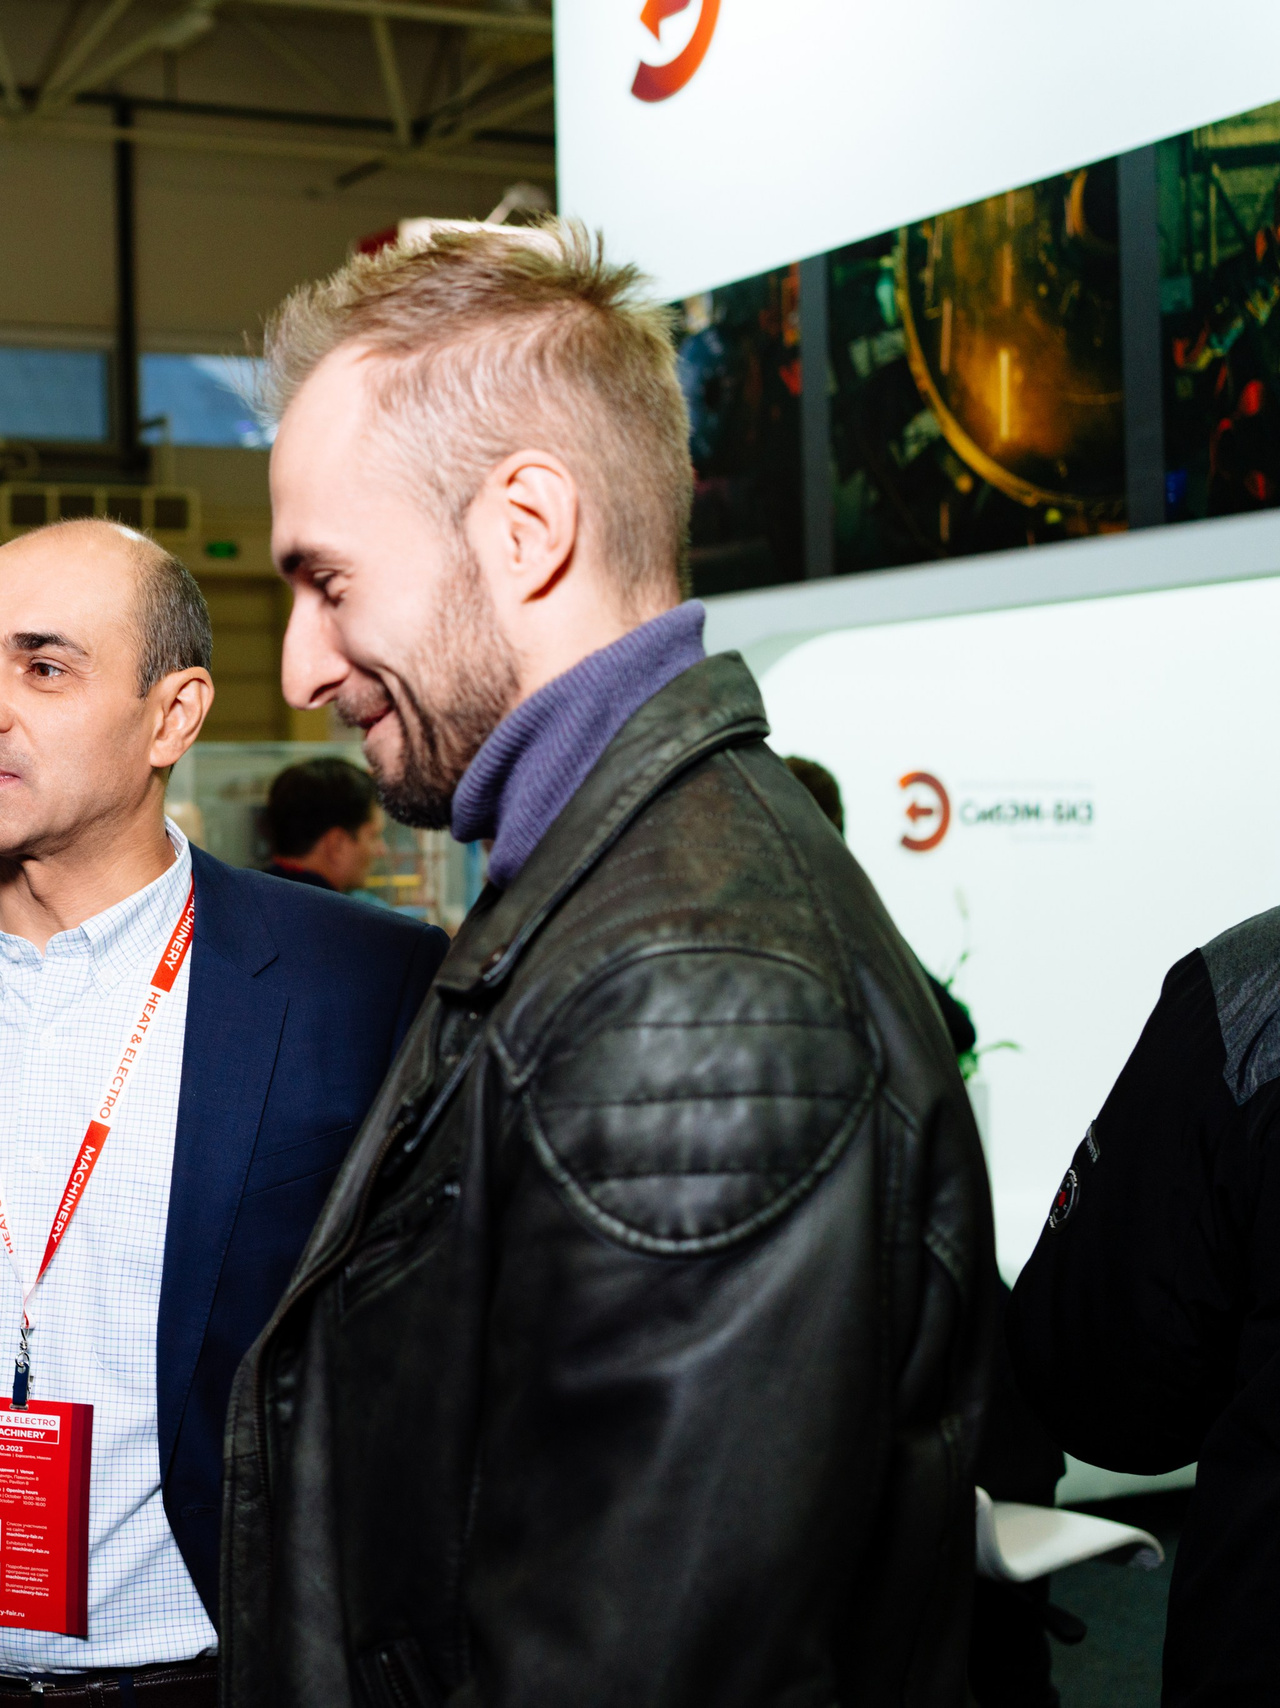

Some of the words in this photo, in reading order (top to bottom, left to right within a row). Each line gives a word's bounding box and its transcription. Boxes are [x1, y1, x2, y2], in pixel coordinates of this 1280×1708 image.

[165, 895, 195, 971] ACHINERY
[130, 1033, 142, 1044] &
[137, 991, 161, 1034] HEAT
[99, 1048, 136, 1119] ELECTRO
[52, 1145, 96, 1243] MACHINERY
[14, 1417, 56, 1426] ELECTRO
